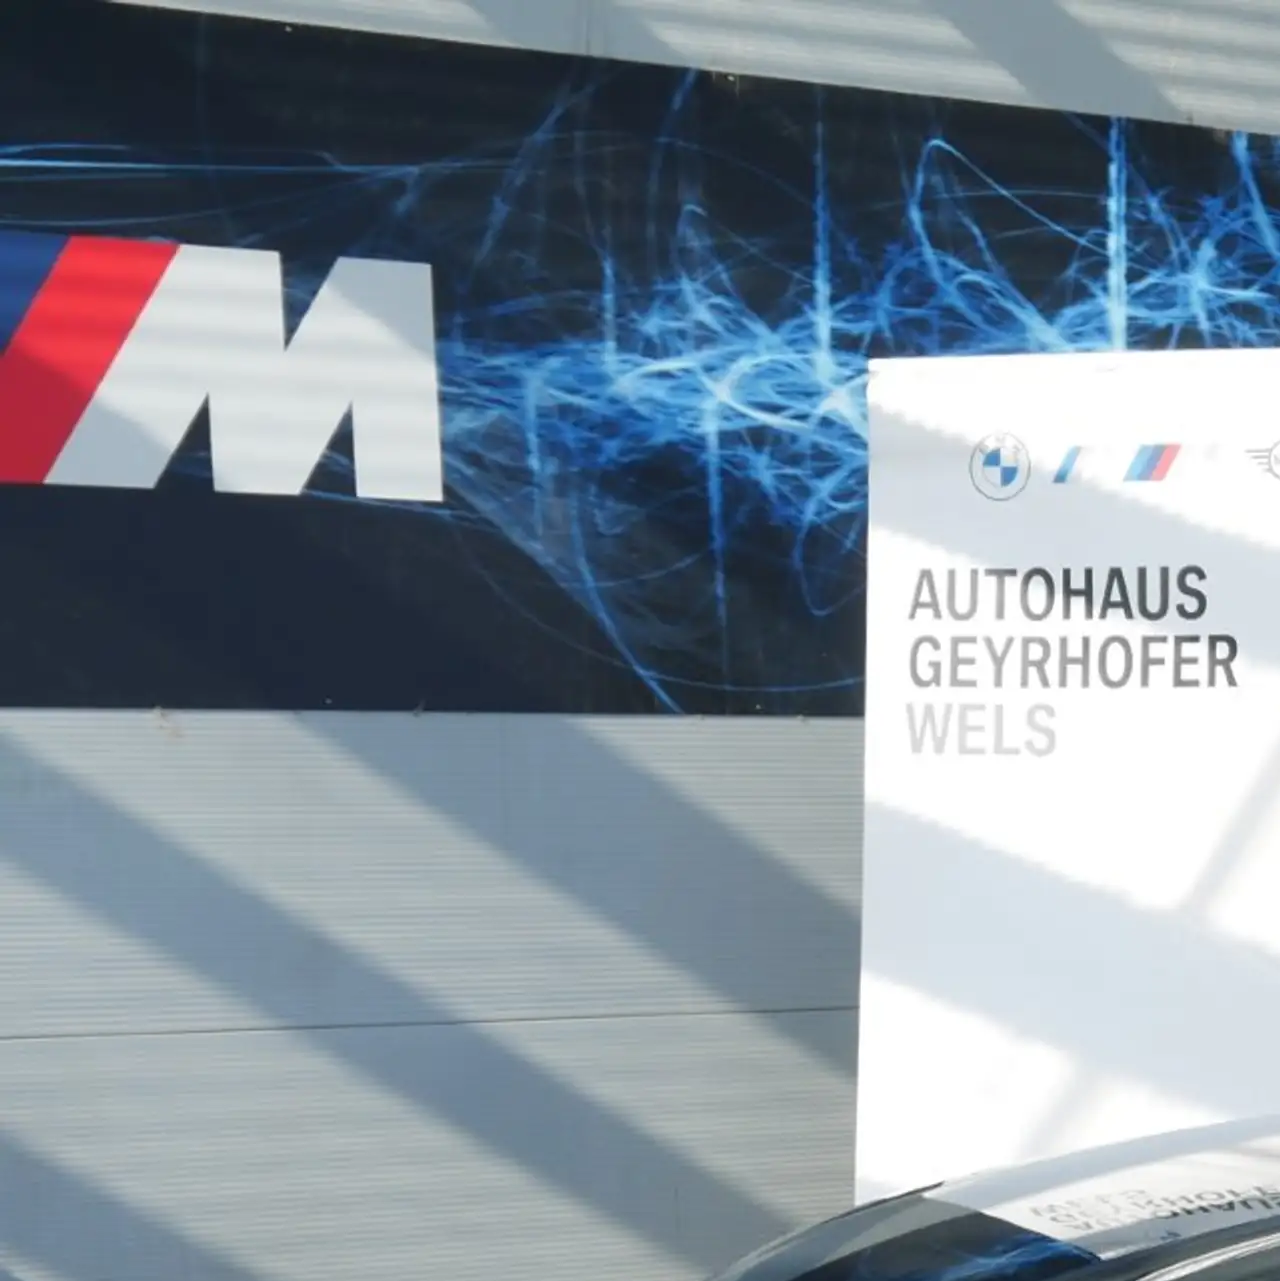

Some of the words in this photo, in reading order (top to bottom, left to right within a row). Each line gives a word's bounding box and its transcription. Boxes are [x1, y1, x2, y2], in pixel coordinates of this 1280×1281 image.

[44, 244, 443, 502] M
[908, 565, 1209, 622] AUTOHAUS
[909, 634, 1239, 690] GEYRHOFER
[906, 702, 1058, 758] WELS
